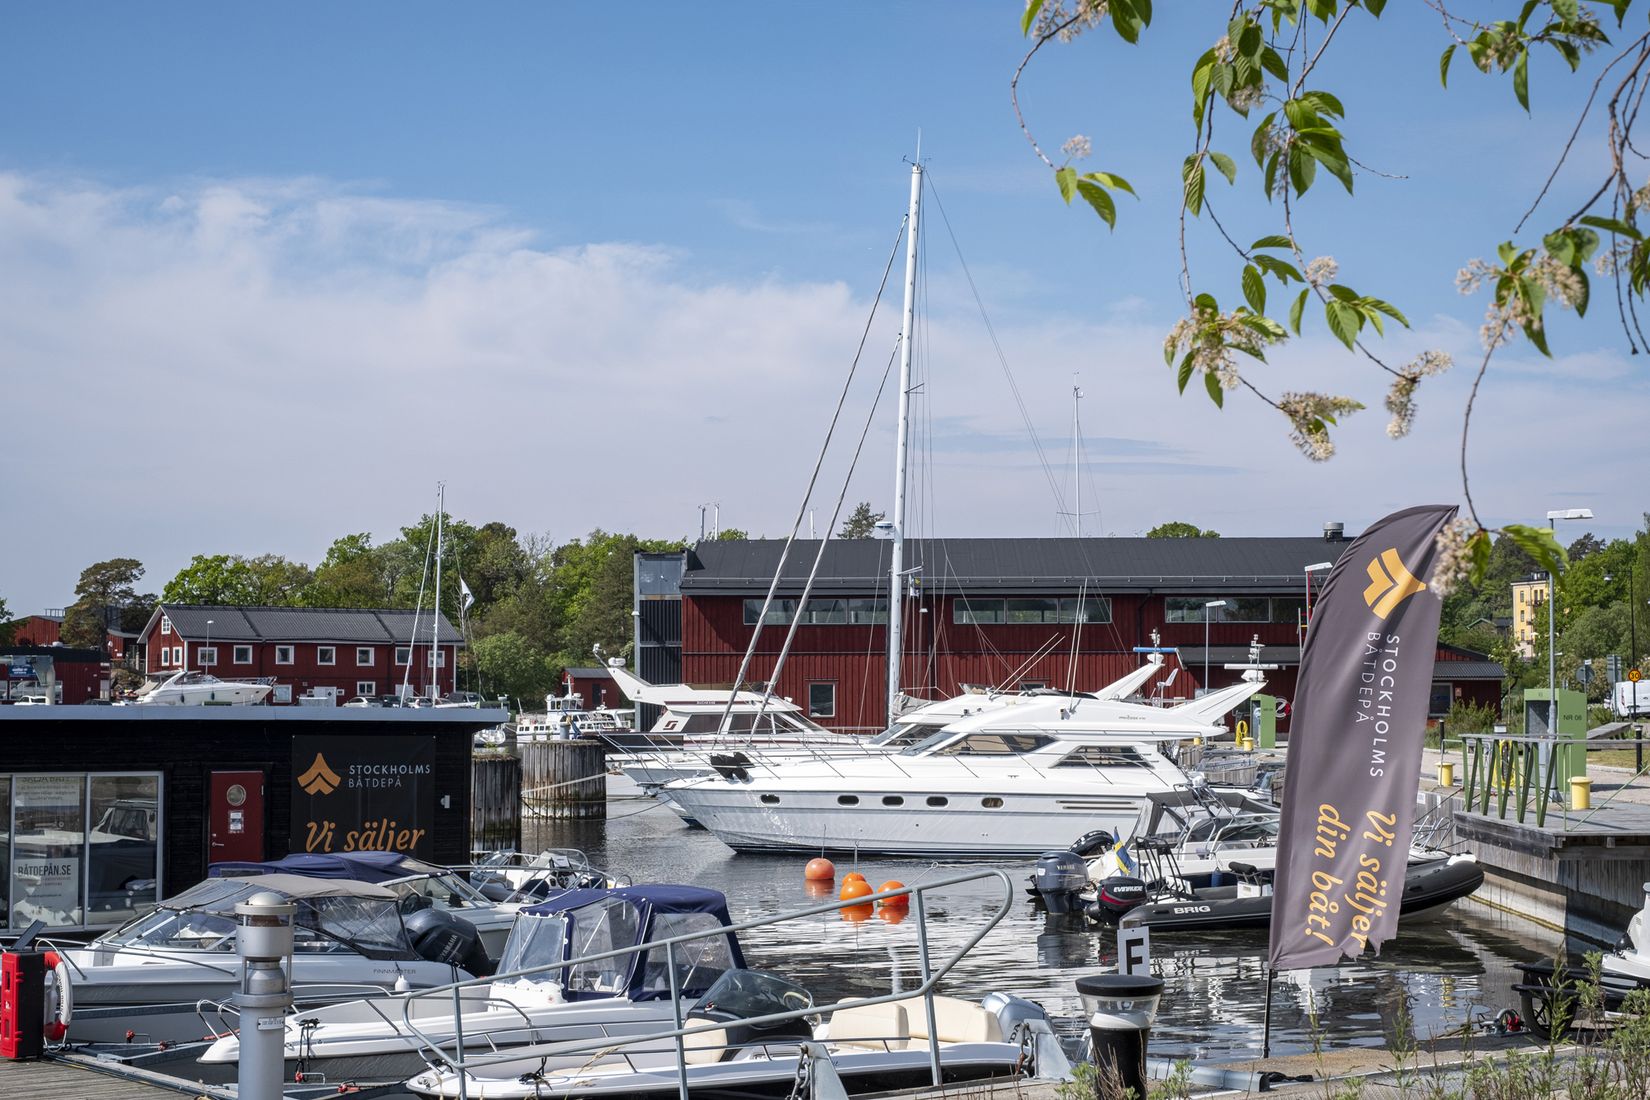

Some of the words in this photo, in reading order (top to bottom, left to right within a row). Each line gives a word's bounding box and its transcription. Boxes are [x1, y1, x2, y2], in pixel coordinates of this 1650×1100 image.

[1355, 632, 1383, 723] BÅTDEPÅ
[1630, 672, 1640, 680] 30
[1369, 634, 1400, 777] STOCKHOLMS
[348, 764, 431, 775] STOCKHOLMS
[348, 775, 402, 789] BÅTDEPÅ
[305, 820, 337, 853] Vi
[343, 818, 425, 852] säljer
[1314, 803, 1351, 859] din
[1363, 810, 1397, 847] Vi
[1173, 905, 1212, 915] BRIG
[1304, 870, 1344, 946] båt!
[1344, 853, 1388, 950] säljer
[442, 934, 458, 958] YAMAHA
[1125, 937, 1145, 975] F
